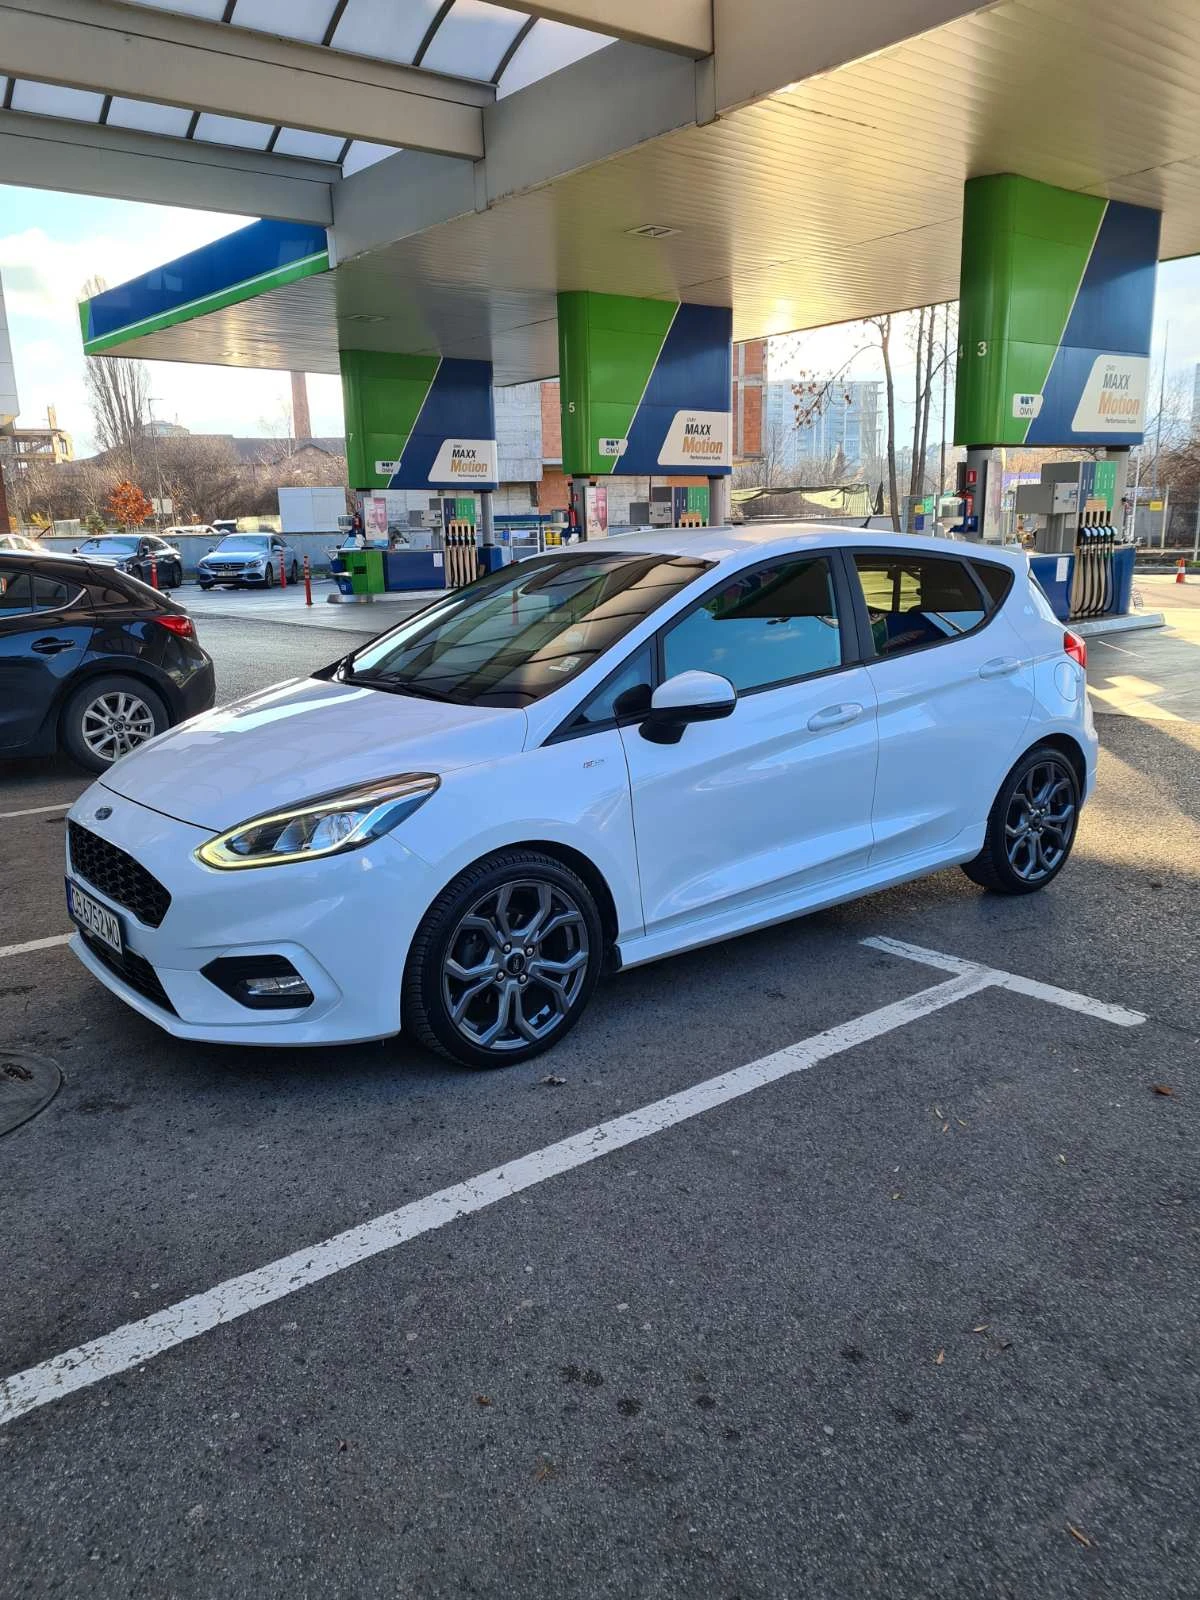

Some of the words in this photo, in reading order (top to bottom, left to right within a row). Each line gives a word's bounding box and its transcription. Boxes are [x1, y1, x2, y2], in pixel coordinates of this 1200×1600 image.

[977, 341, 987, 357] 3
[1103, 372, 1131, 390] MAXX
[569, 401, 575, 413] 5
[1098, 391, 1140, 416] Motion
[1020, 407, 1034, 416] OMV
[685, 423, 711, 436] MAXX
[682, 436, 723, 454] Motion
[452, 449, 476, 459] MAXX
[451, 459, 488, 473] Motion
